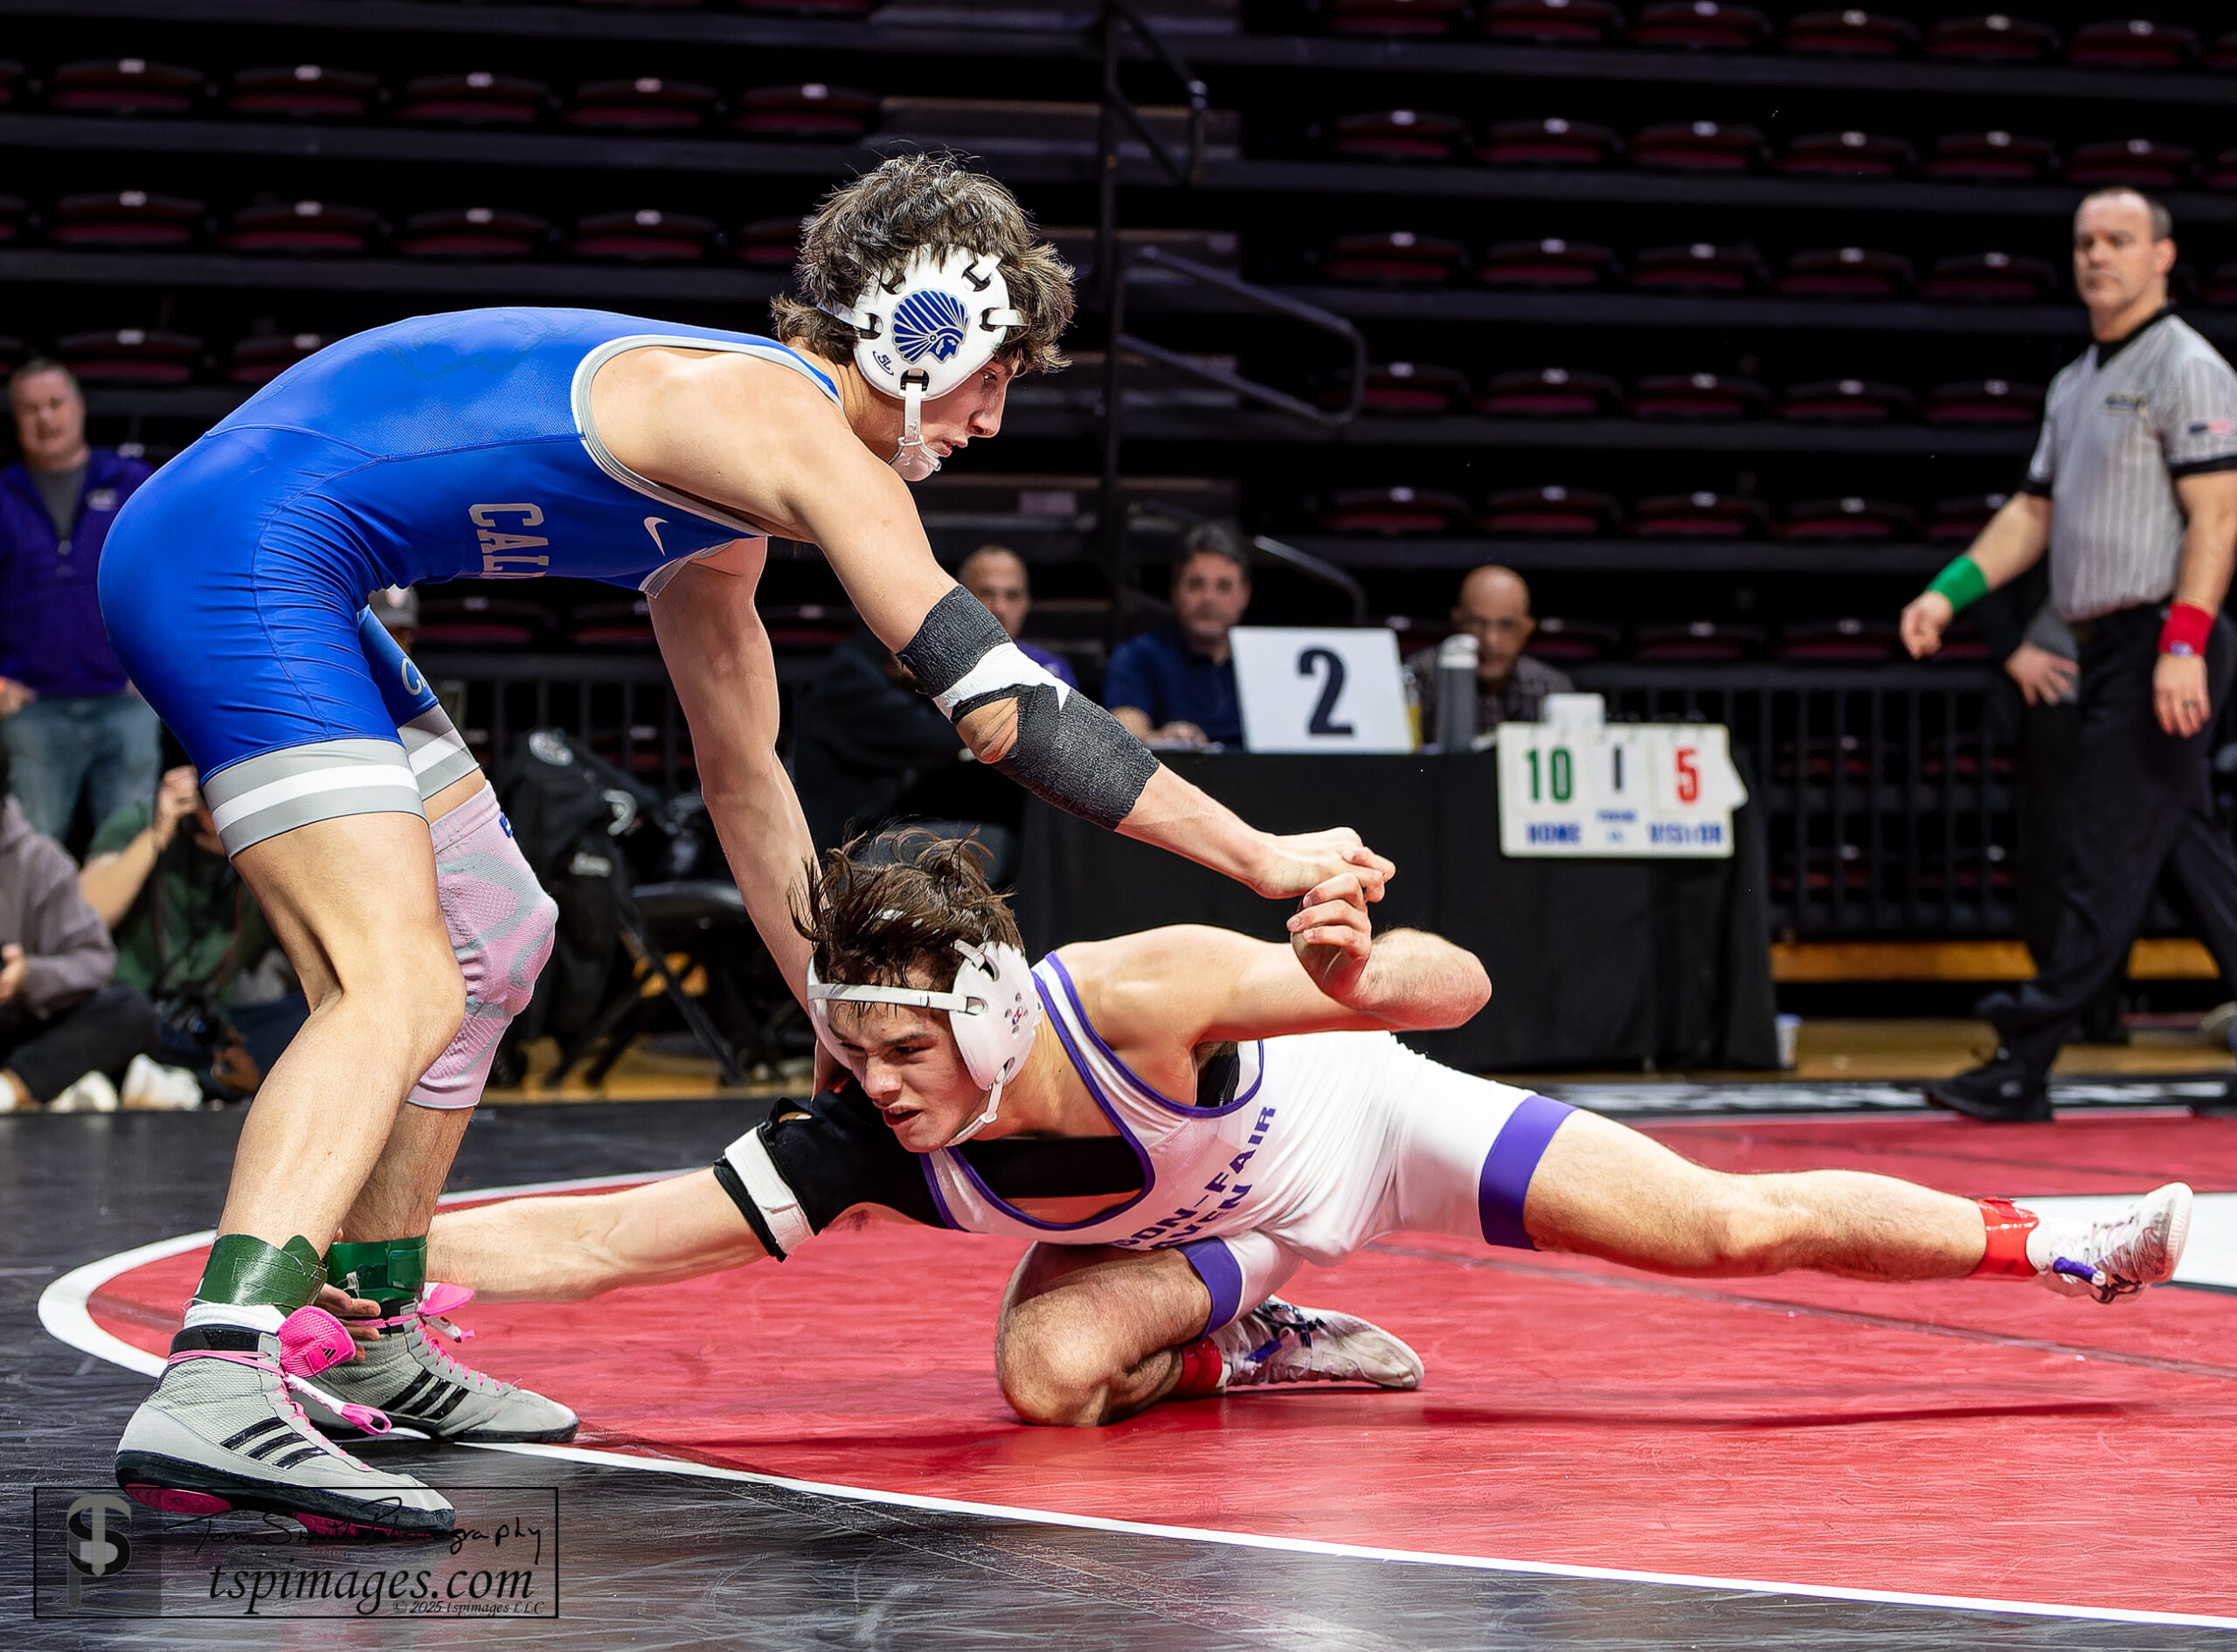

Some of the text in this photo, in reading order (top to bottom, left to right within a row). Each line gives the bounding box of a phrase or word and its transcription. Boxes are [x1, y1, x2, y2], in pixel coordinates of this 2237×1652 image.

[1299, 649, 1354, 735] 2
[1525, 748, 1572, 802] 10
[1675, 748, 1699, 803] 5
